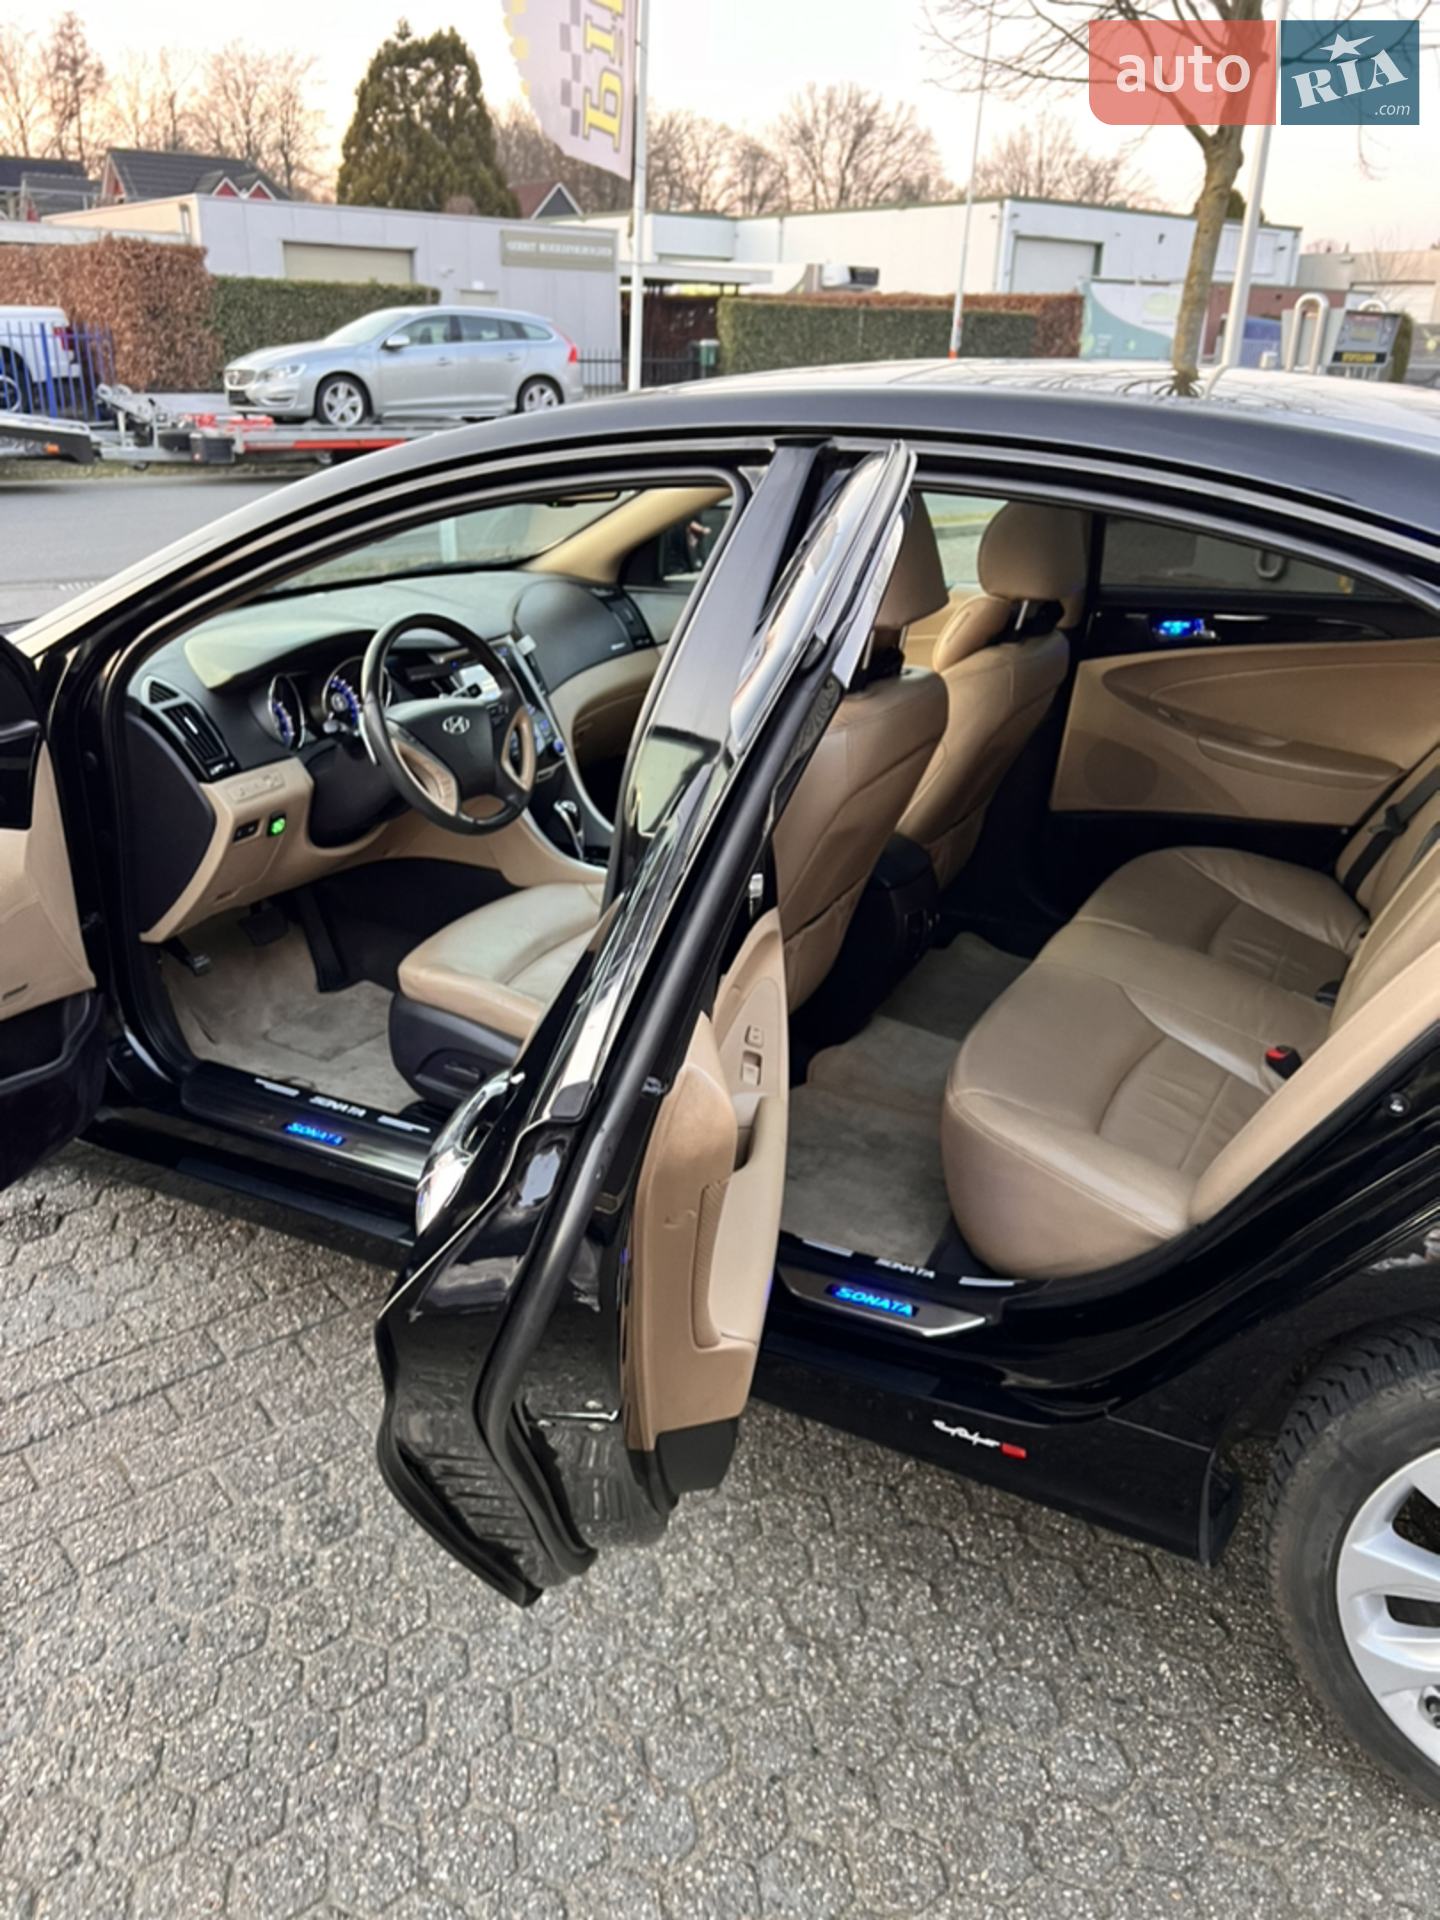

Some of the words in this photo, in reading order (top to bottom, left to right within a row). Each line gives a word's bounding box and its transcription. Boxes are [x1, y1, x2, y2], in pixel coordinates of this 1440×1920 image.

[309, 1095, 367, 1117] SONATA
[286, 1122, 343, 1146] SONATA
[875, 1257, 935, 1279] SONATA
[834, 1286, 913, 1317] SONATA
